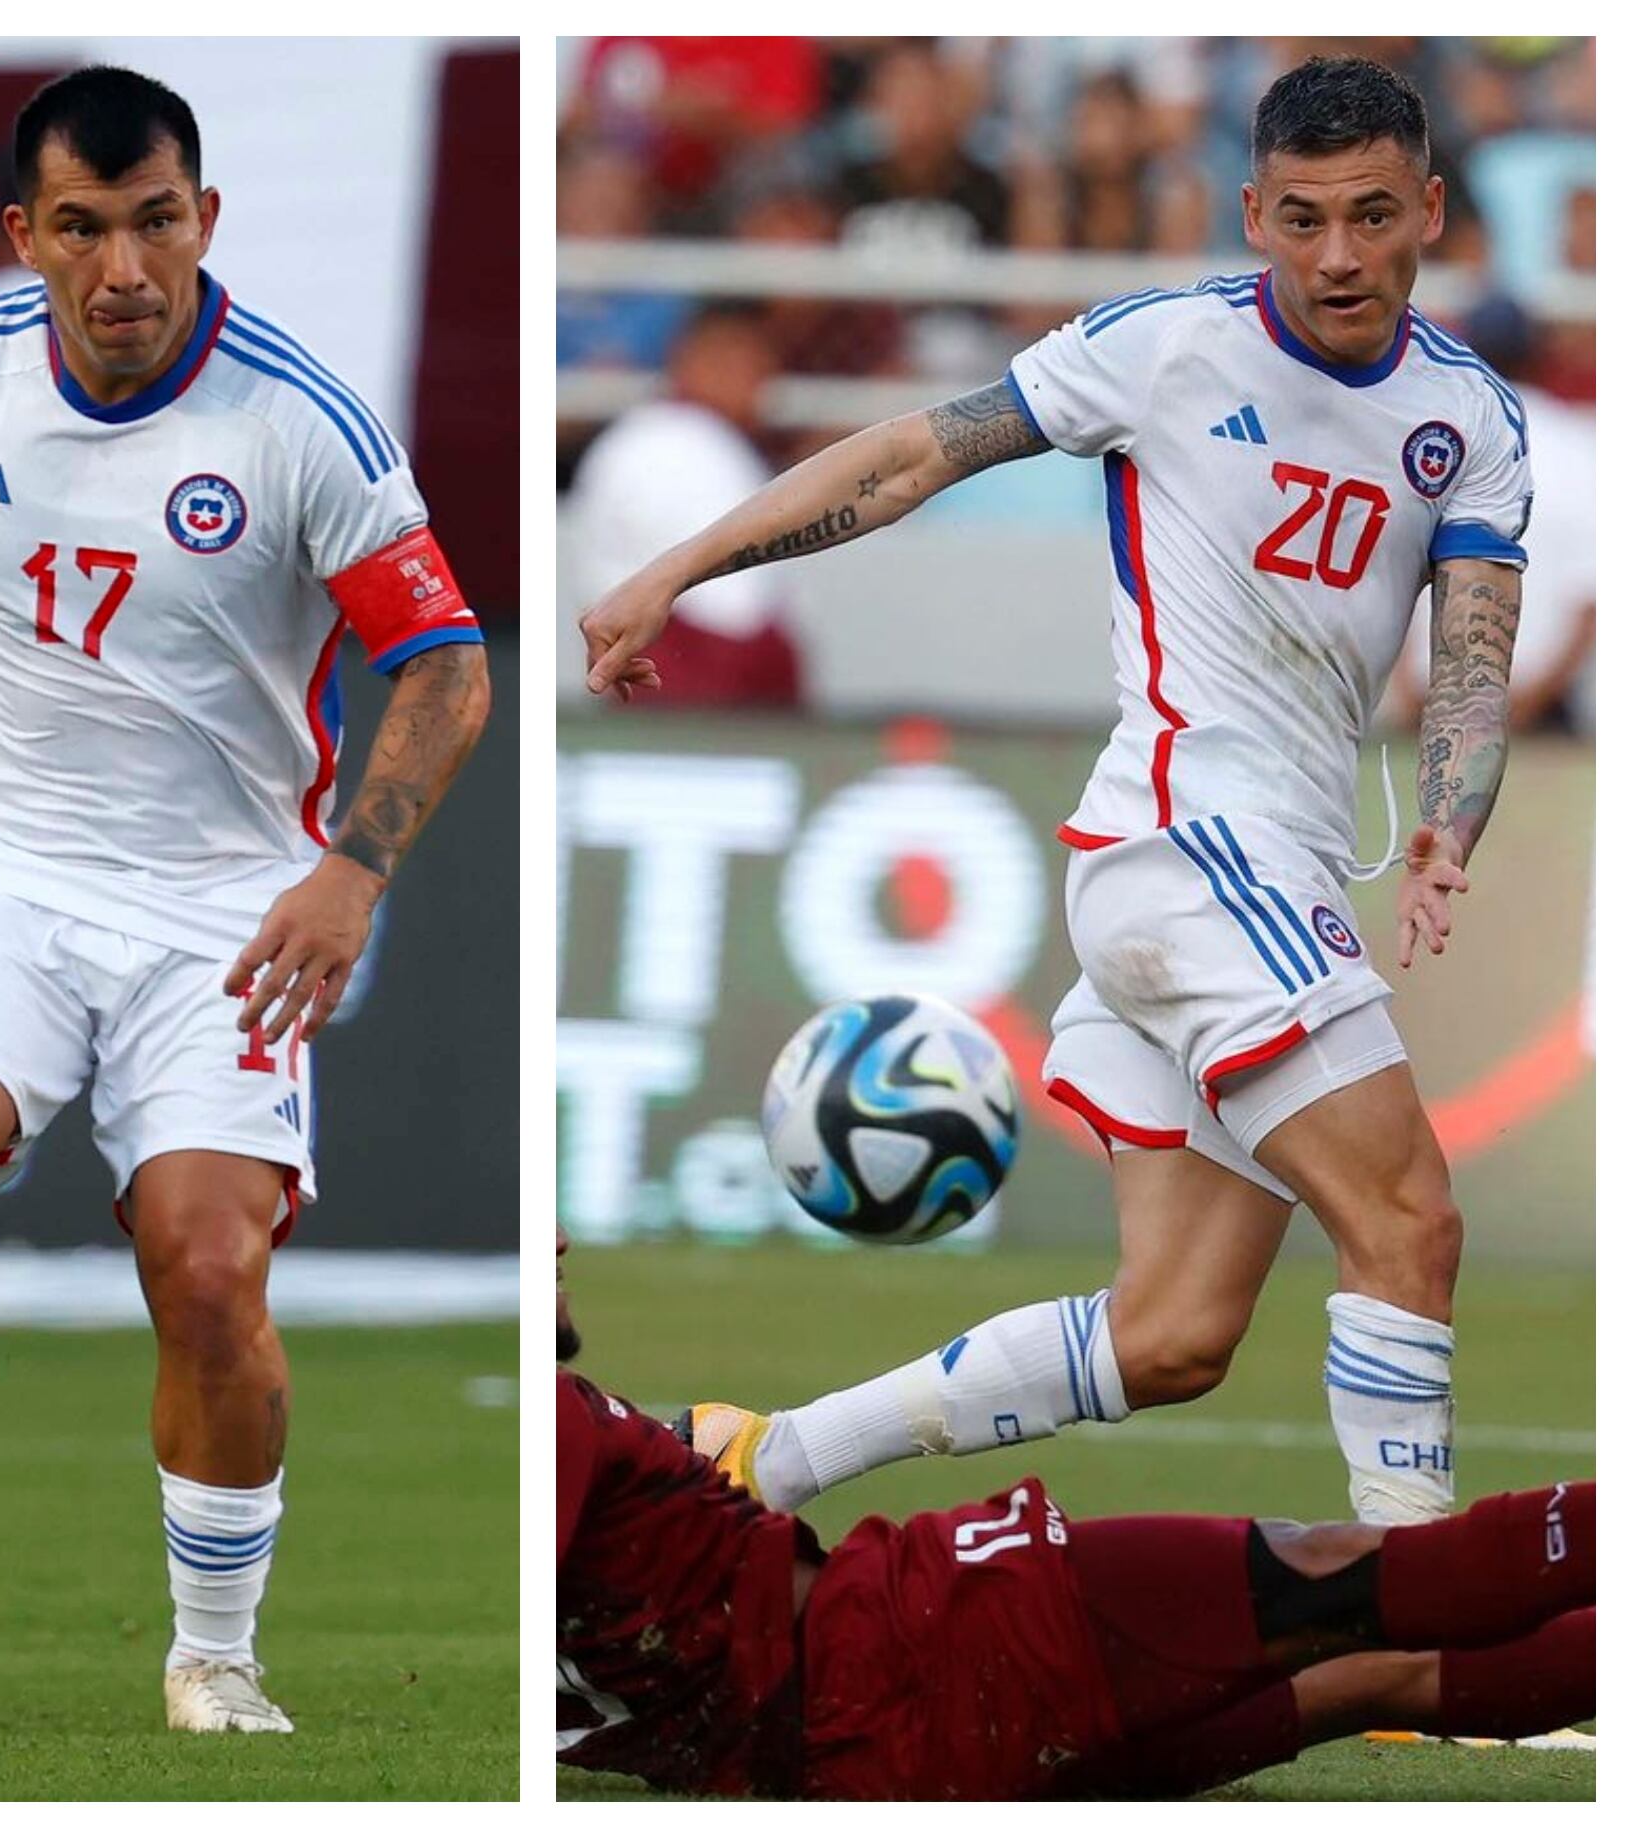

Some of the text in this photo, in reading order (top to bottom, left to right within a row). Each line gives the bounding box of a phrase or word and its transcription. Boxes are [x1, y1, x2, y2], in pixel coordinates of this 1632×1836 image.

[730, 504, 857, 570] Renato
[1254, 462, 1390, 590] 20
[21, 543, 137, 660] 17
[558, 752, 1050, 1018] TO
